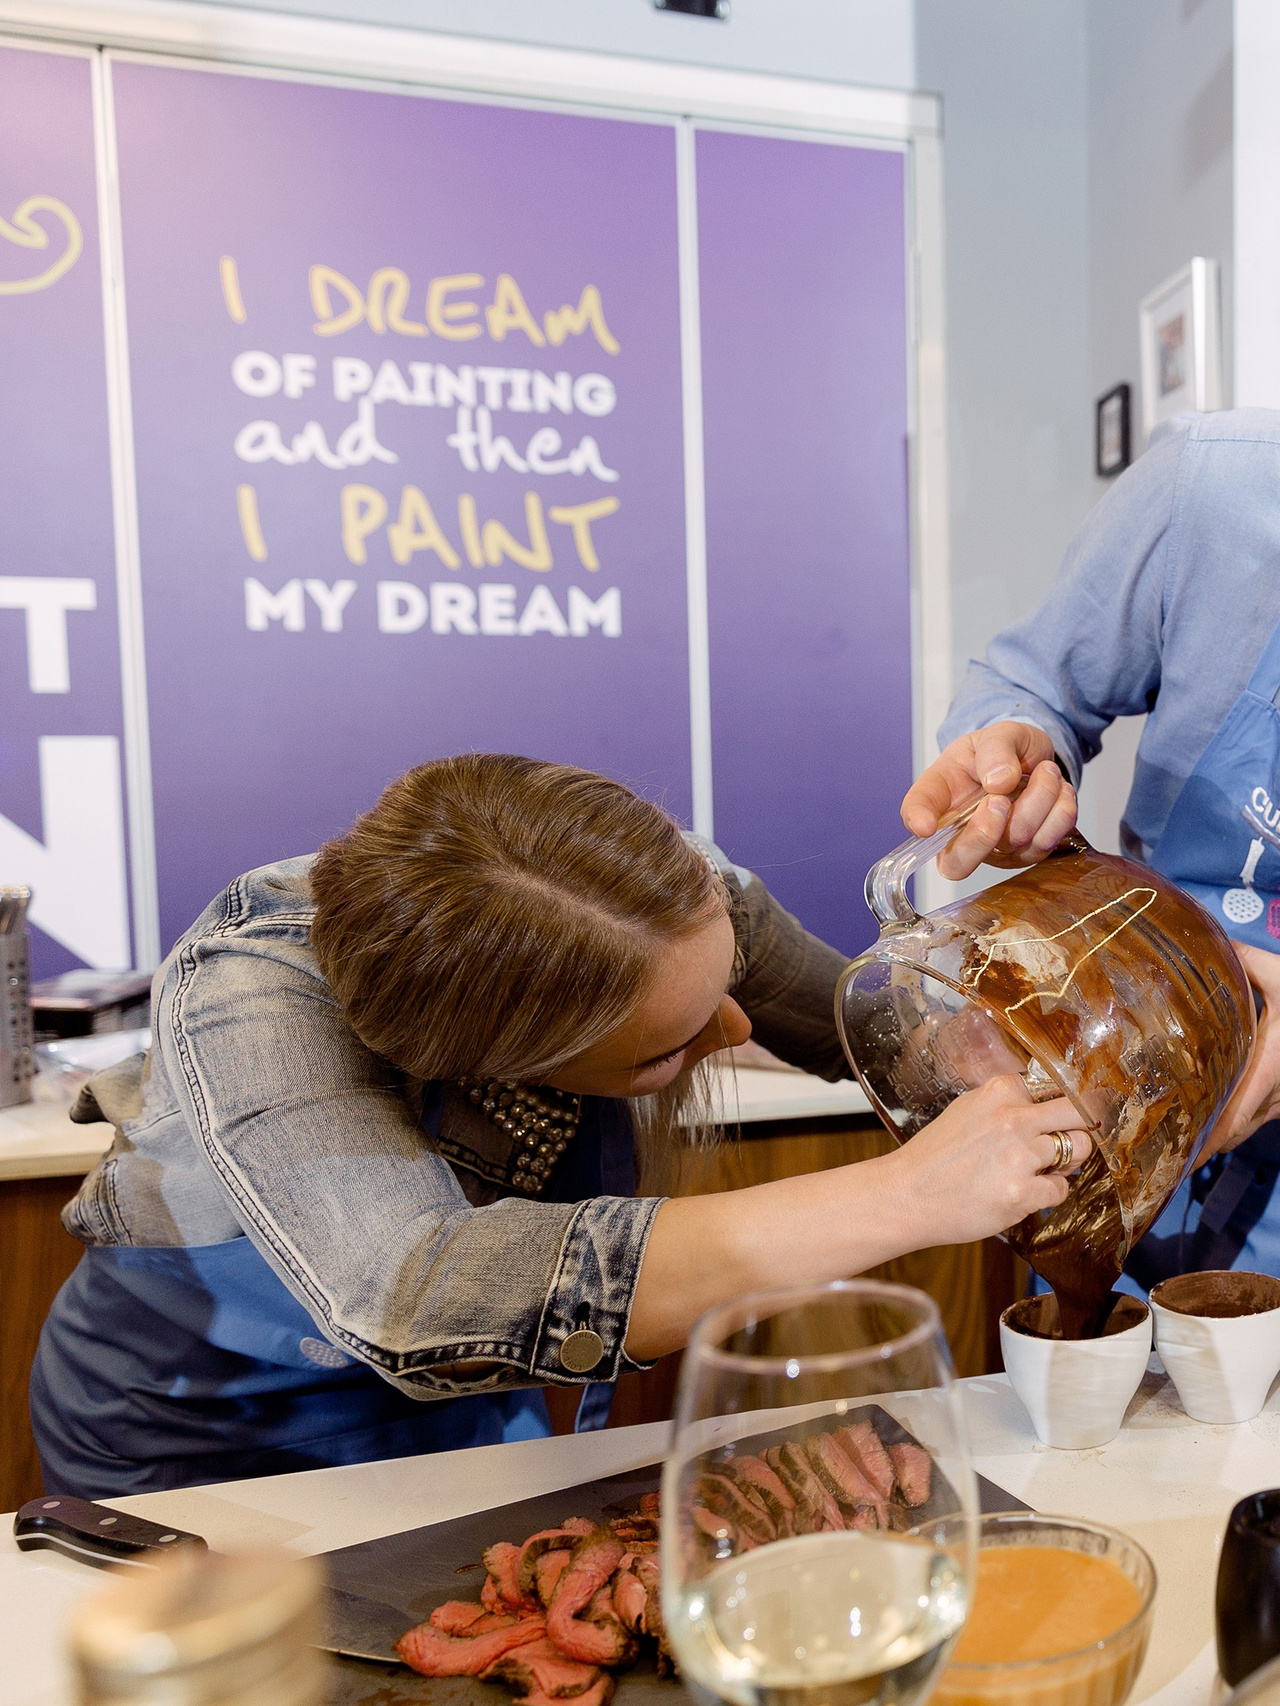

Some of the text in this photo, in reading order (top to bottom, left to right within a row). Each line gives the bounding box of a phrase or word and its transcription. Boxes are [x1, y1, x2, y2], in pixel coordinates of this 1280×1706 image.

[220, 254, 620, 355] I DREAM
[231, 350, 618, 417] OF PAINTING
[234, 396, 619, 482] and then
[237, 483, 620, 572] I PAINT
[243, 575, 622, 639] MY DREAM
